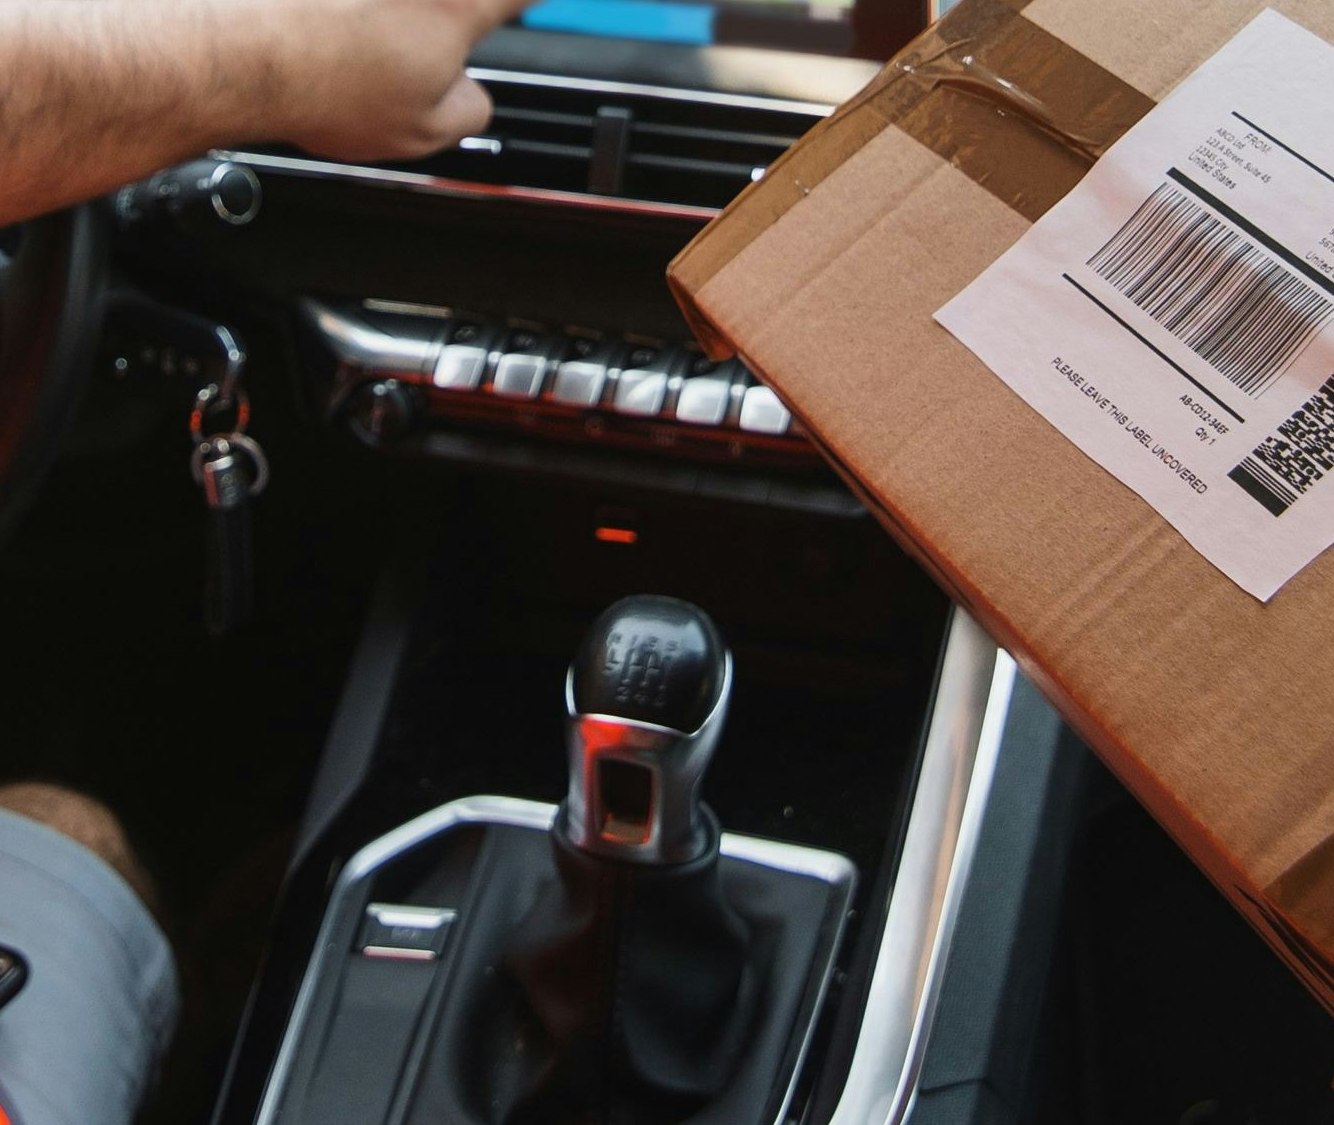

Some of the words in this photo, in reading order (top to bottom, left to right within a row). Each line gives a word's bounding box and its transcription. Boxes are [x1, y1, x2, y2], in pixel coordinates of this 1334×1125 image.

[1188, 152, 1213, 173] United
[1211, 169, 1237, 190] States
[1195, 145, 1218, 162] 12345
[1215, 158, 1229, 171] City
[1205, 136, 1220, 148] 123
[1243, 162, 1262, 177] Suite
[1261, 174, 1272, 184] 45
[1304, 251, 1334, 274] United
[1051, 357, 1085, 387] PLEASE
[1080, 383, 1110, 410] LEAVE
[1107, 405, 1129, 426] THIS
[1125, 422, 1153, 449] LABEL
[1151, 444, 1209, 495] UNCOVERED
[1179, 394, 1230, 436] AB-CD12-34EF
[1194, 427, 1210, 442] Qty
[1208, 438, 1216, 446] 1
